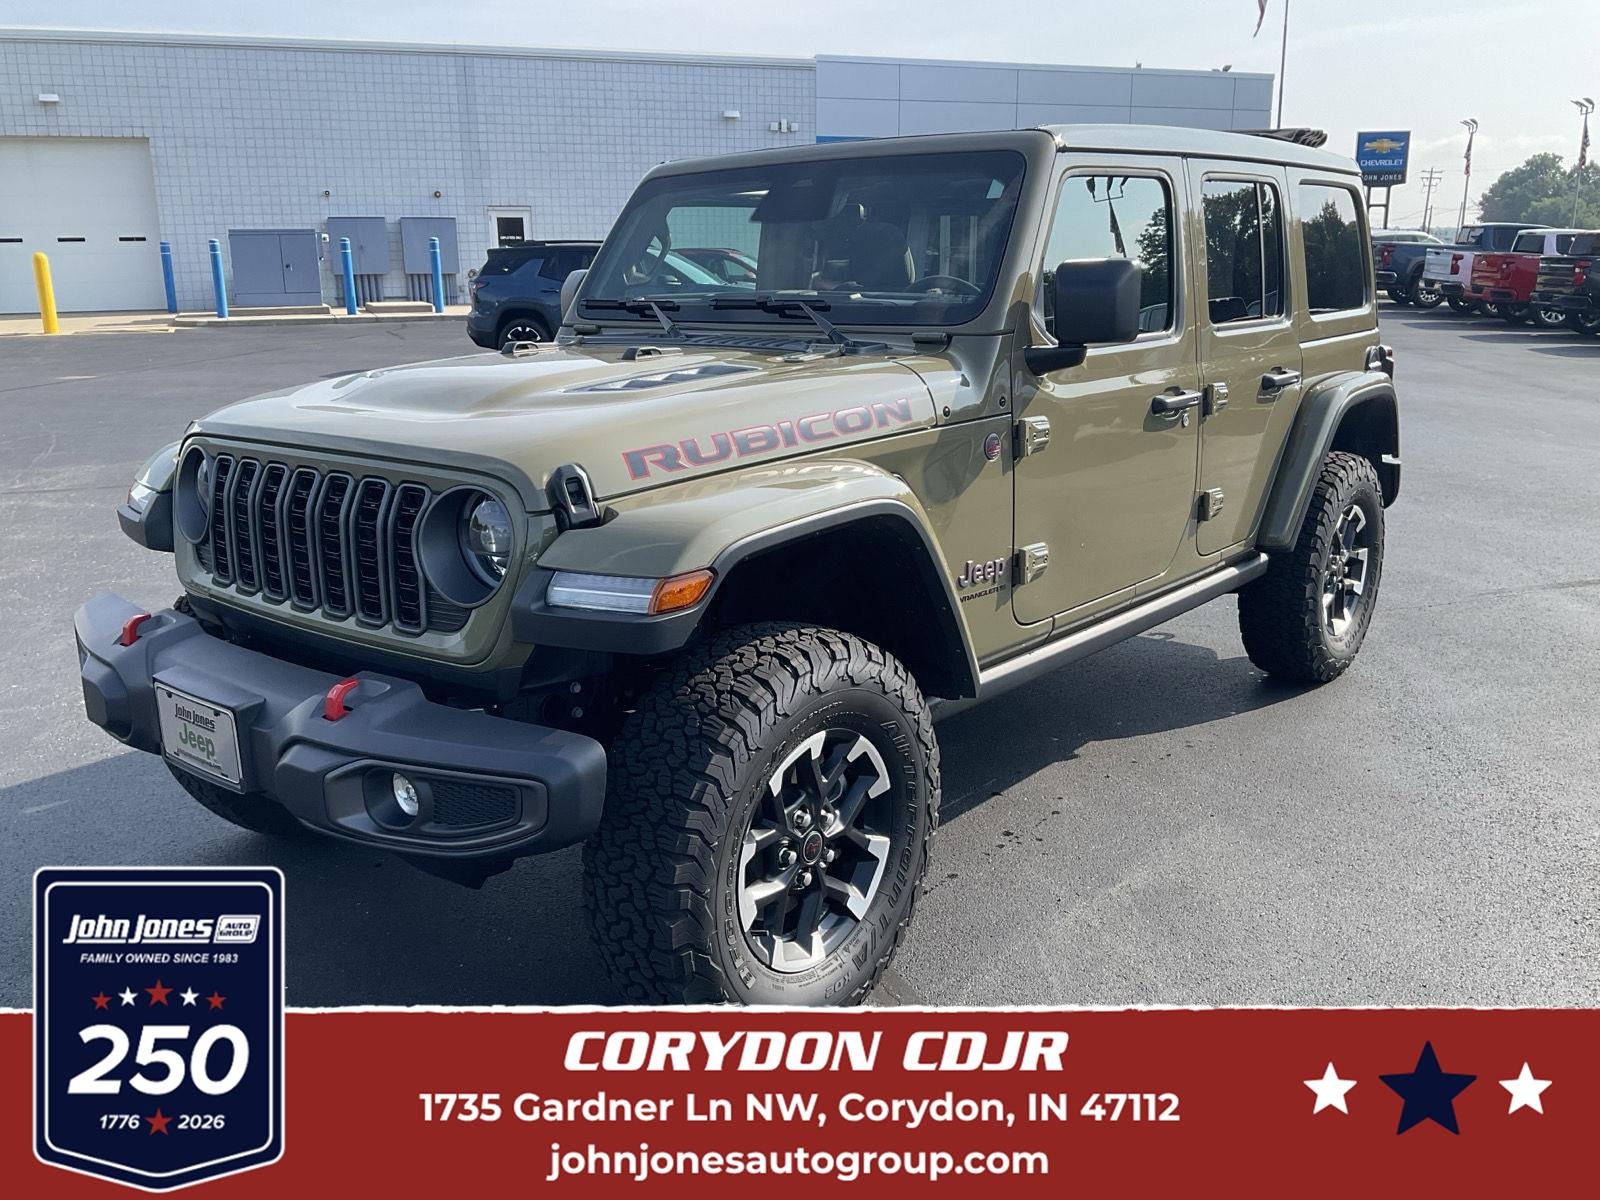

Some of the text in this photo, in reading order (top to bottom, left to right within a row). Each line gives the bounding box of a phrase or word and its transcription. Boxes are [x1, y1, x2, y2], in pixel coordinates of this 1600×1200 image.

[1360, 159, 1403, 167] CHEVROLET
[622, 397, 912, 480] RUBICON
[956, 557, 1005, 588] Jeep
[960, 586, 999, 603] WRANGLER
[174, 703, 216, 730] John Jones
[179, 722, 216, 760] Jeep
